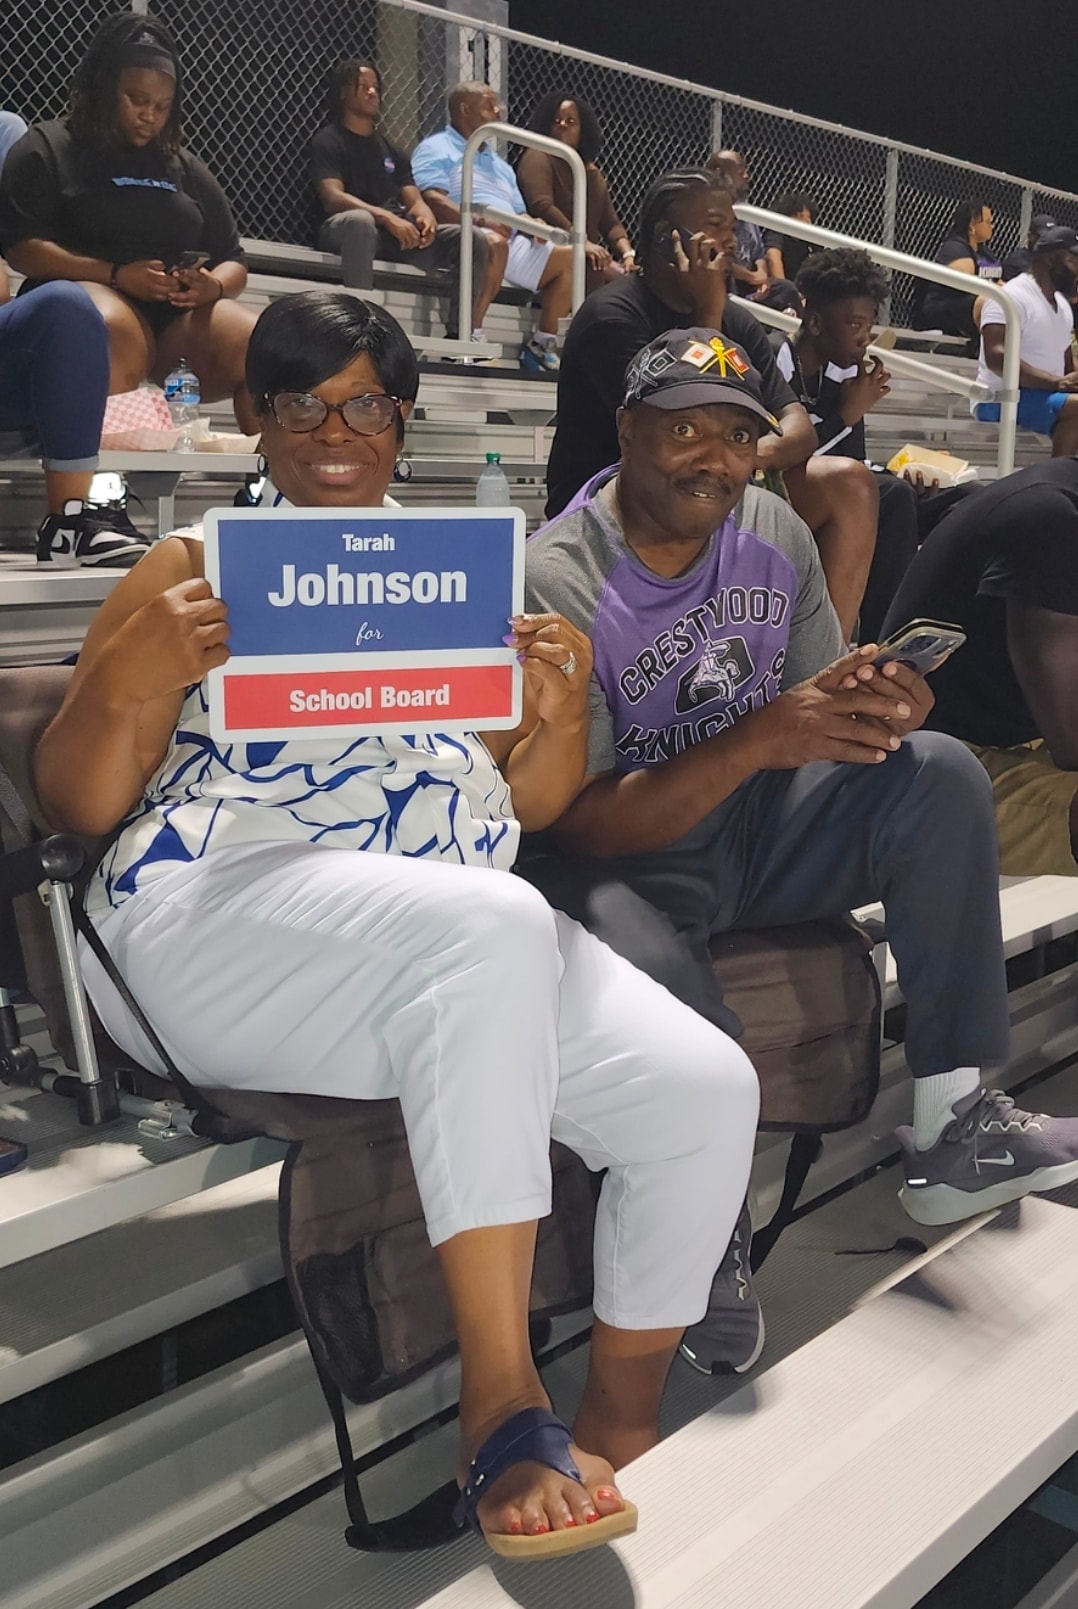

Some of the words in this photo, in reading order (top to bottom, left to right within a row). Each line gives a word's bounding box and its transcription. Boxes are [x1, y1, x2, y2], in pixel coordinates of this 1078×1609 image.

[342, 533, 396, 552] Tarah
[267, 563, 468, 608] Johnson
[355, 621, 385, 646] for
[289, 687, 373, 713] School
[379, 684, 451, 709] Board
